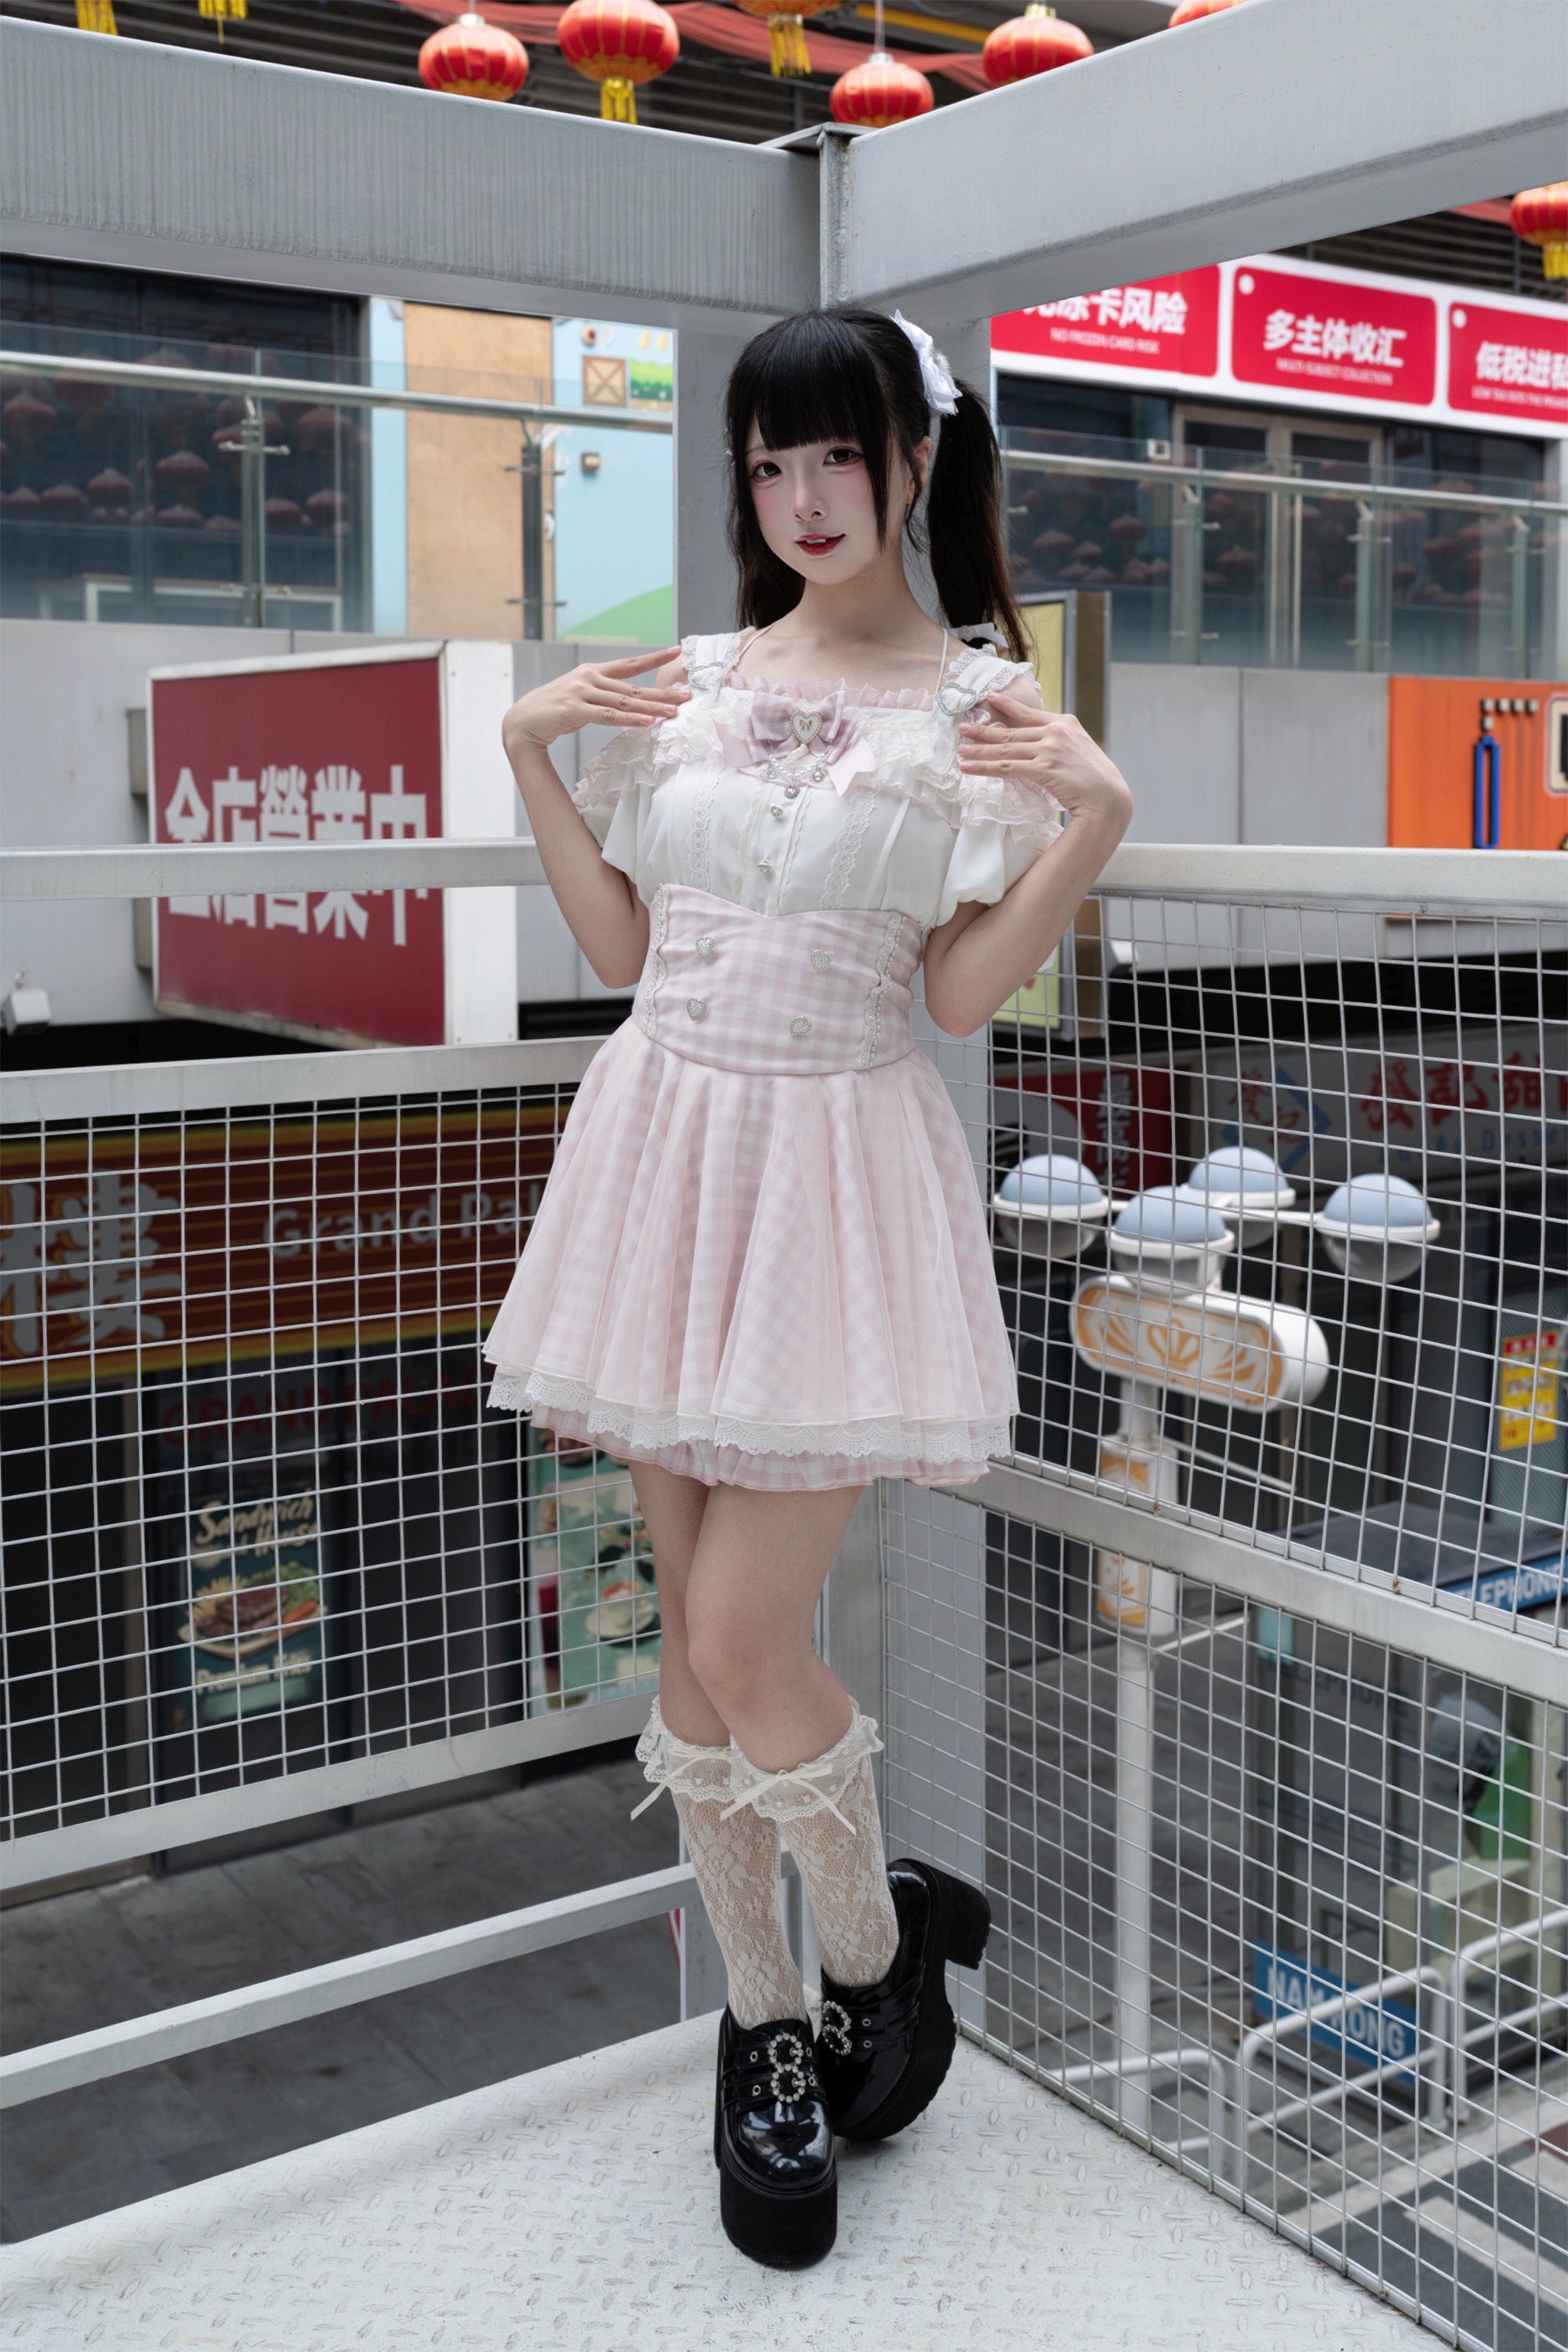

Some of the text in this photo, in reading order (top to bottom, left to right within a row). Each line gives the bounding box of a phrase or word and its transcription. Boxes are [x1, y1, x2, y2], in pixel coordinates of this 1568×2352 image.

[263, 1193, 441, 1258] Grand
[162, 1364, 495, 1447] GRAND PALAC
[196, 1487, 313, 1546] Sandwich
